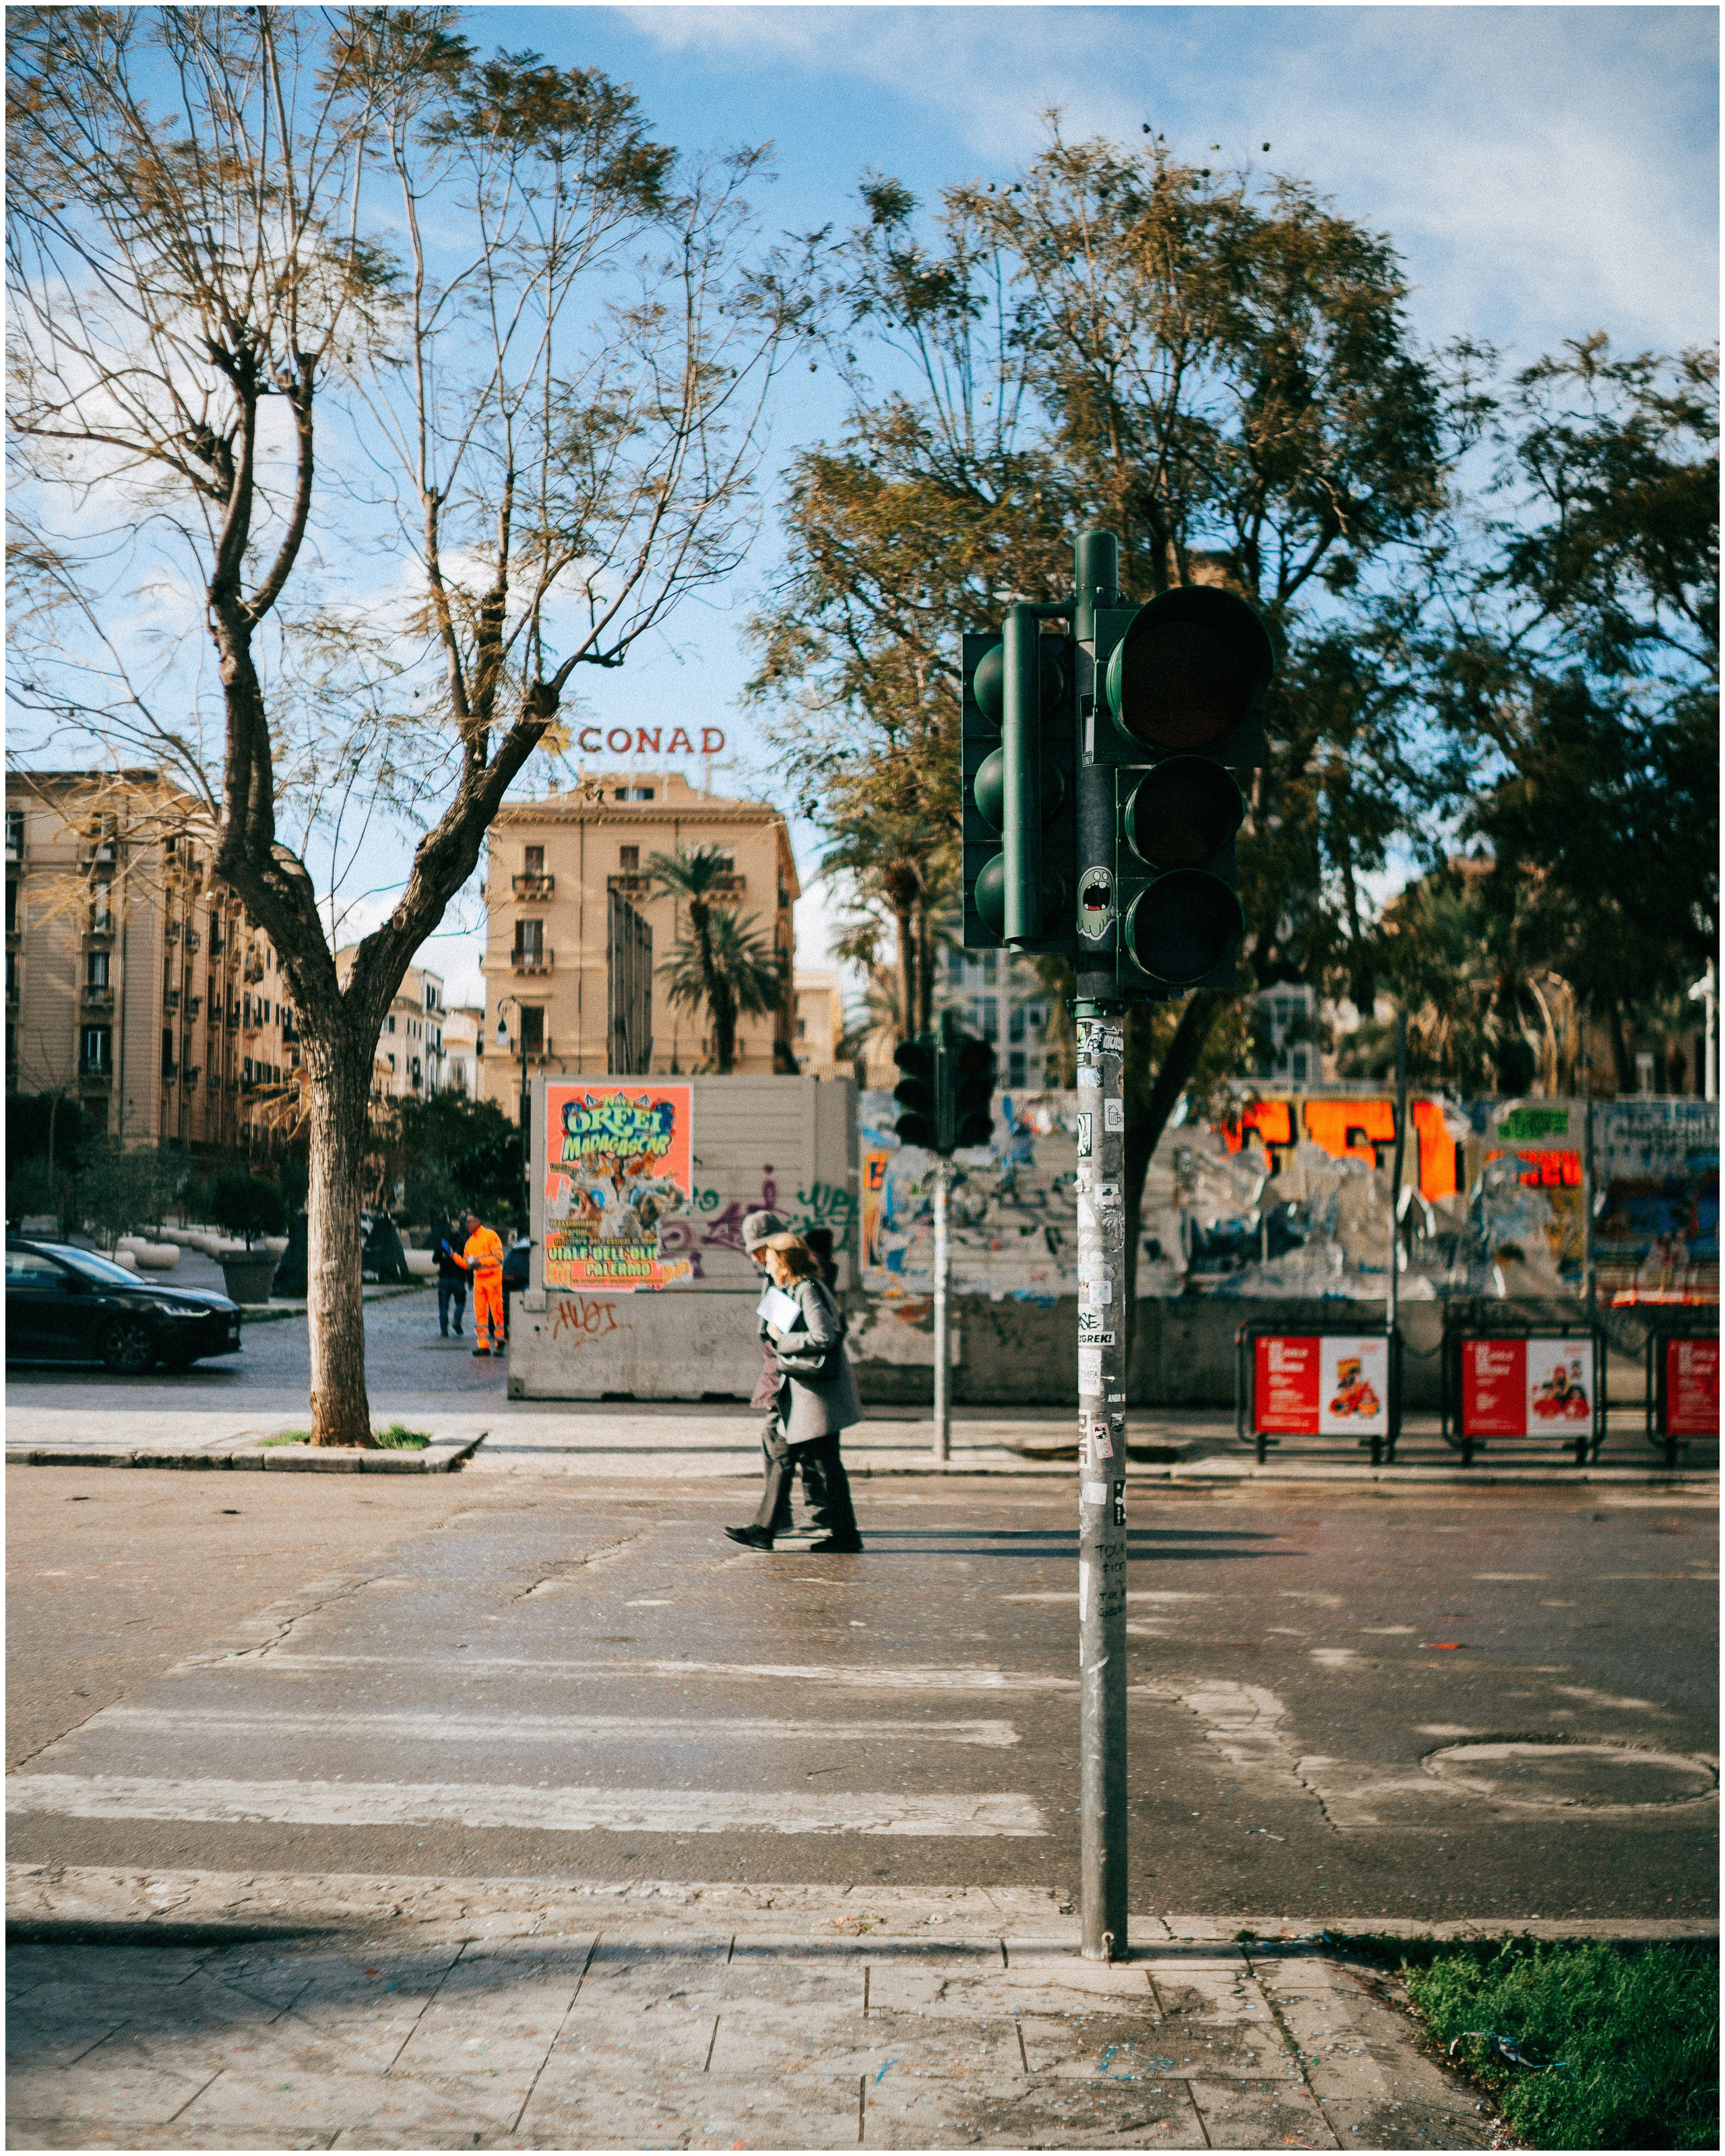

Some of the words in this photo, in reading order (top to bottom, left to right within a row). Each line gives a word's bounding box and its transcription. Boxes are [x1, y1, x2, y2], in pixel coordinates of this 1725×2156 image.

[579, 727, 724, 753] CONAD
[567, 1108, 663, 1137] ORFEI
[563, 1135, 669, 1161] MADAGASCAR
[549, 1247, 589, 1261] VIALE
[586, 1263, 652, 1277] PALERMO
